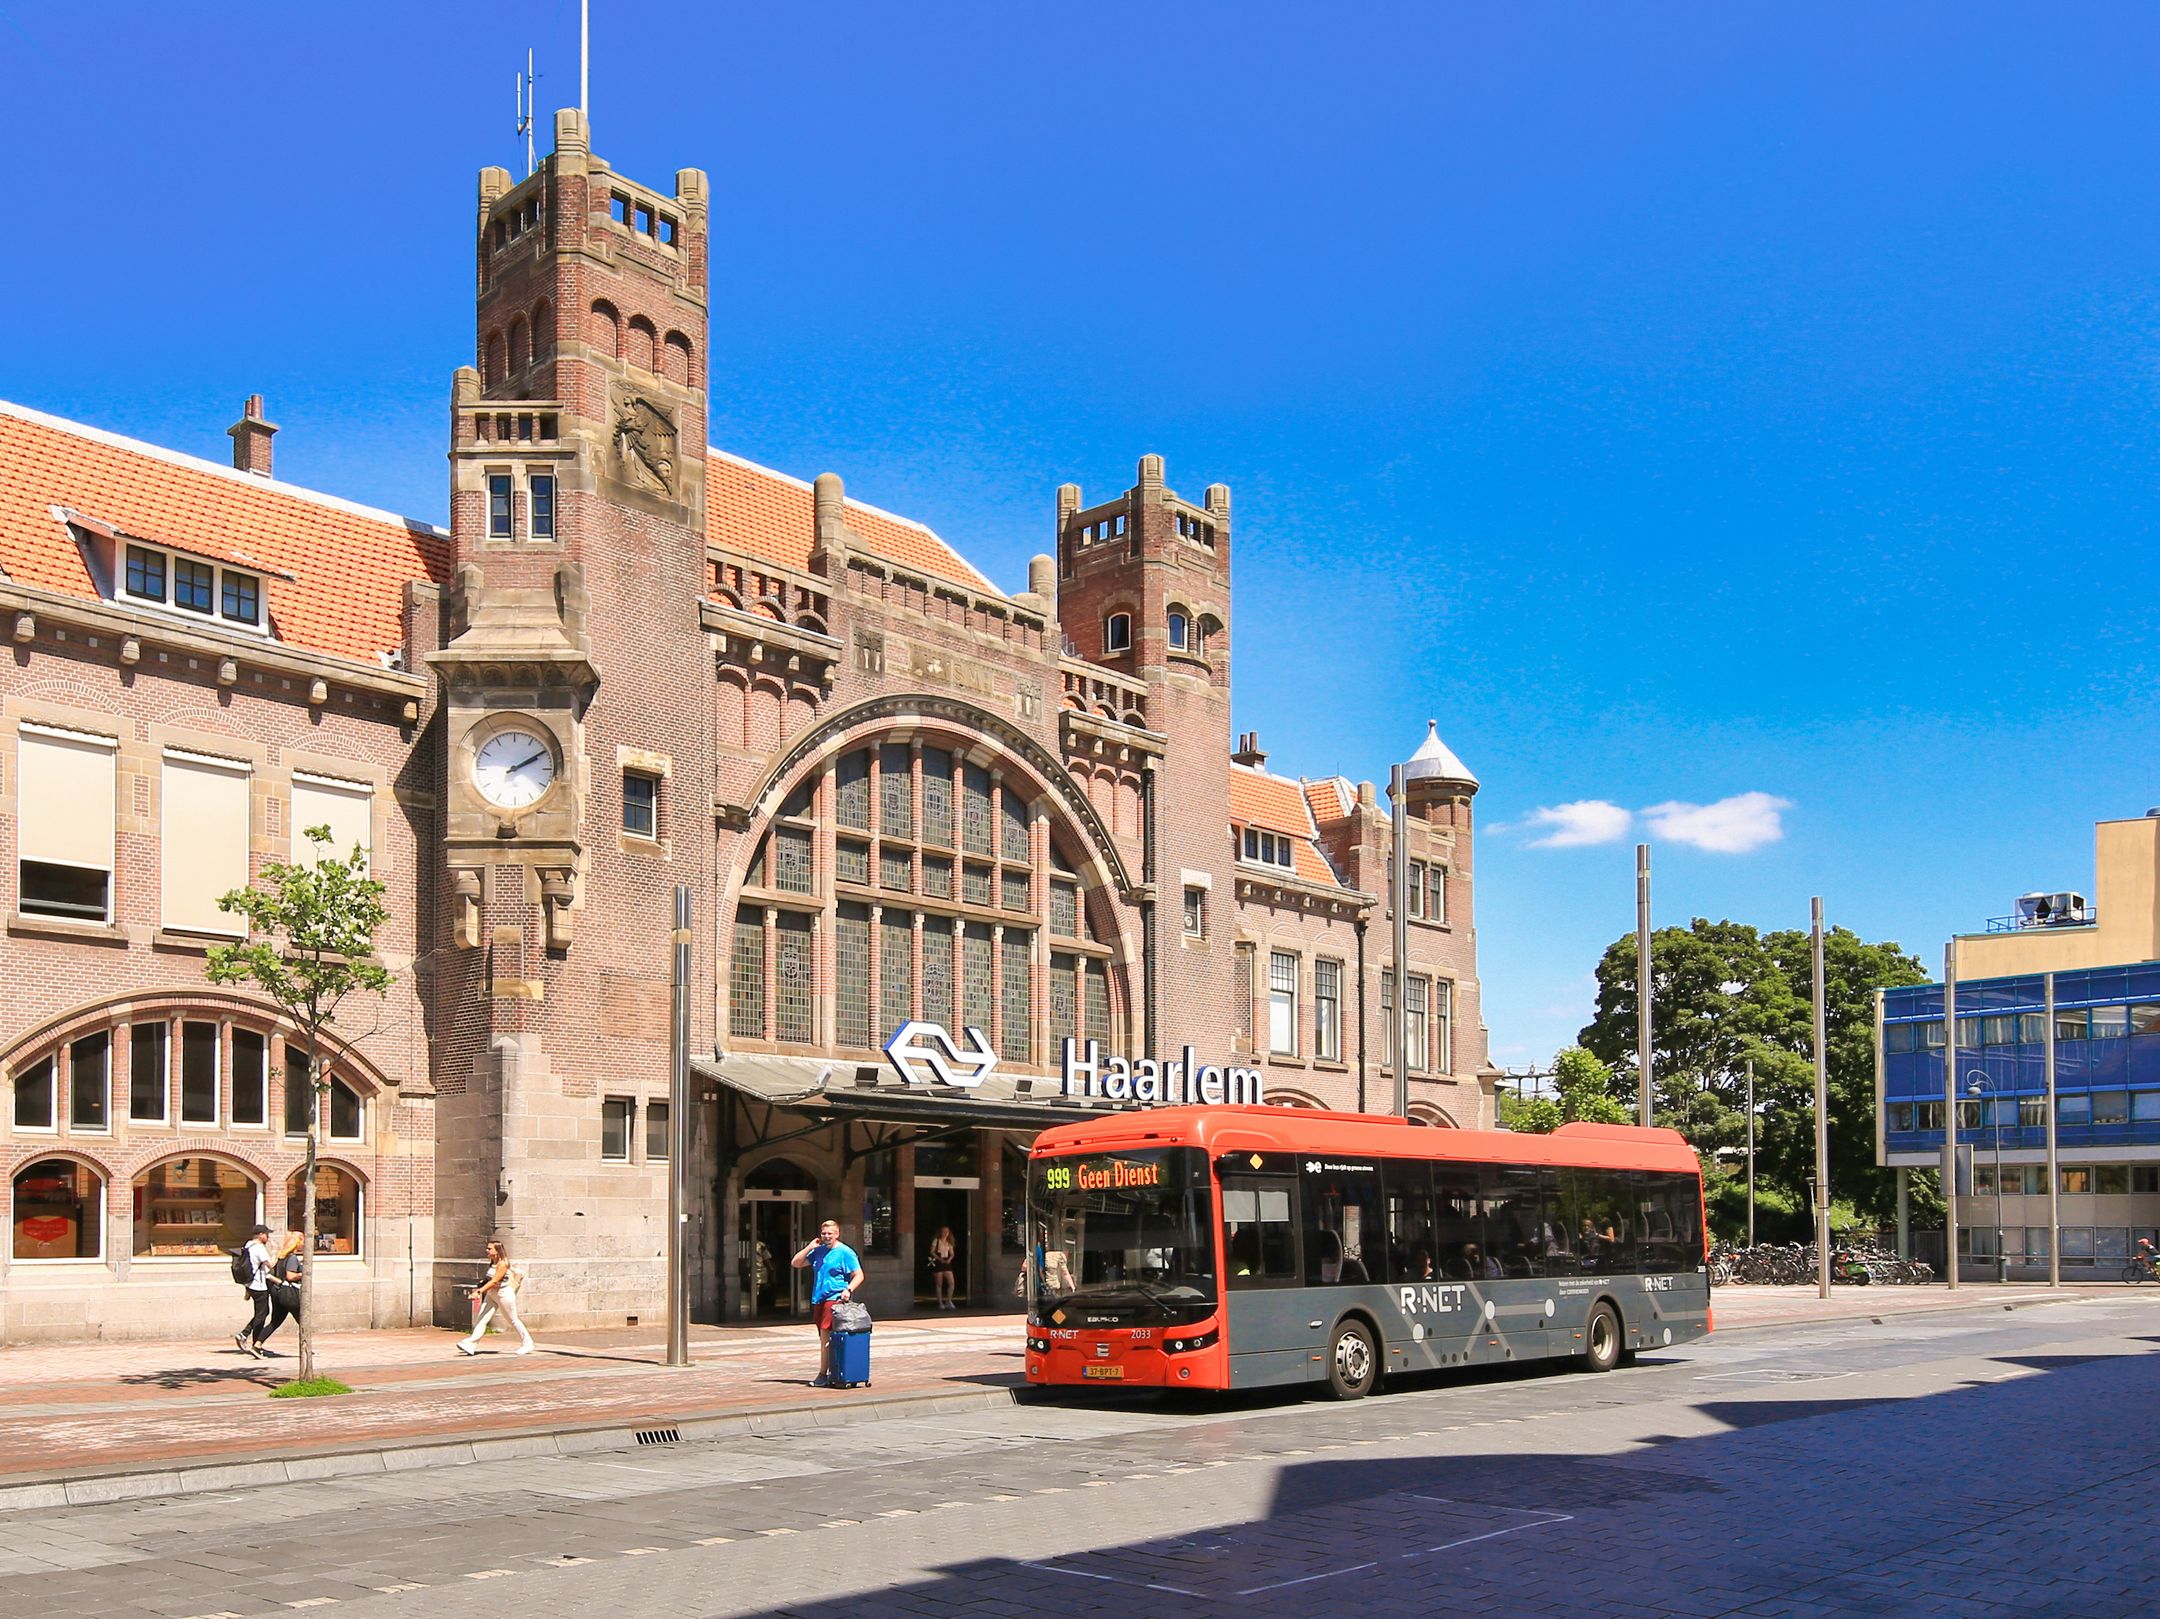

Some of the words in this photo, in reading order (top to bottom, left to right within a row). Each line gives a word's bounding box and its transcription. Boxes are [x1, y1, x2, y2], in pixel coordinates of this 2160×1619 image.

[1061, 1036, 1264, 1105] Haarlem
[1047, 1168, 1070, 1189] 999
[1078, 1164, 1110, 1189] Geen
[1114, 1161, 1159, 1187] Dienst
[1131, 1329, 1151, 1339] 2033
[1090, 1366, 1119, 1376] 37-BPT-7
